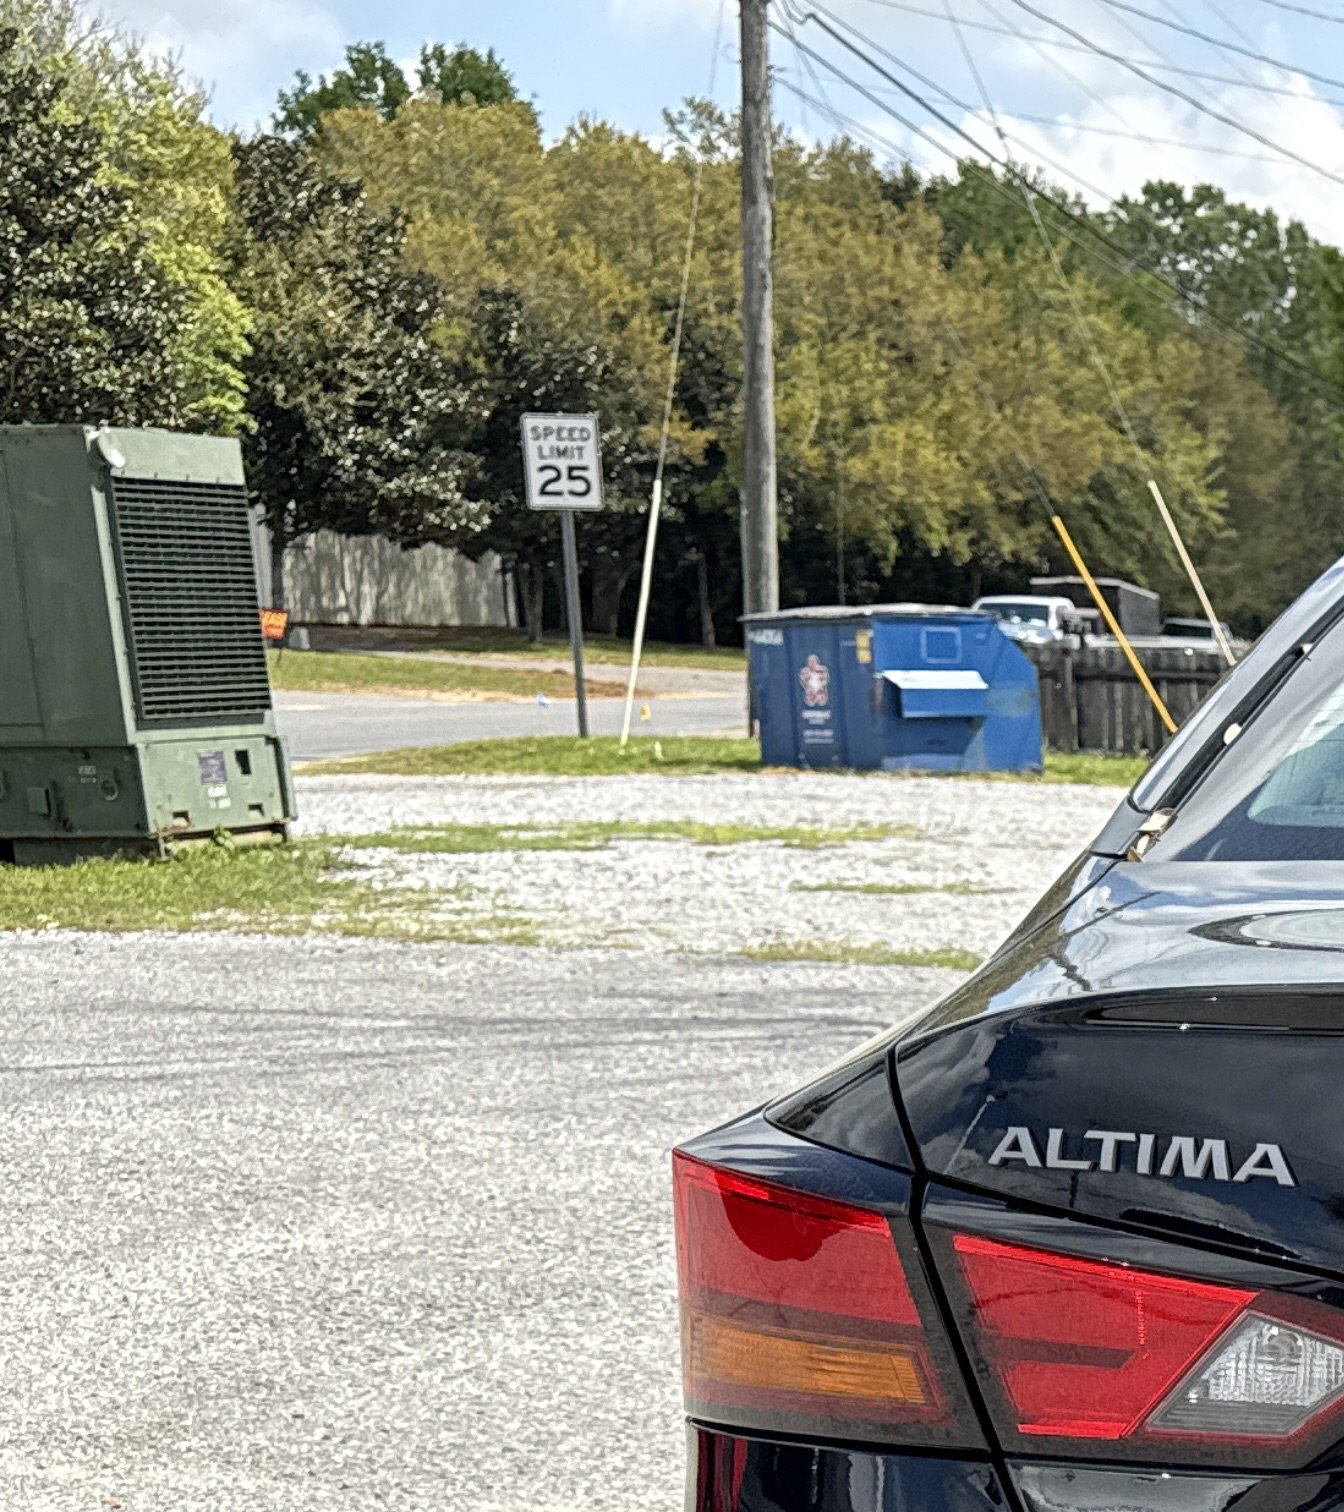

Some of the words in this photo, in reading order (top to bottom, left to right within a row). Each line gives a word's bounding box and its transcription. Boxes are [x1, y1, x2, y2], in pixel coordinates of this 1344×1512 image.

[530, 425, 591, 442] SPEED
[537, 444, 585, 460] LIMIT
[537, 464, 591, 497] 25
[988, 1126, 1297, 1187] ALTIMA
